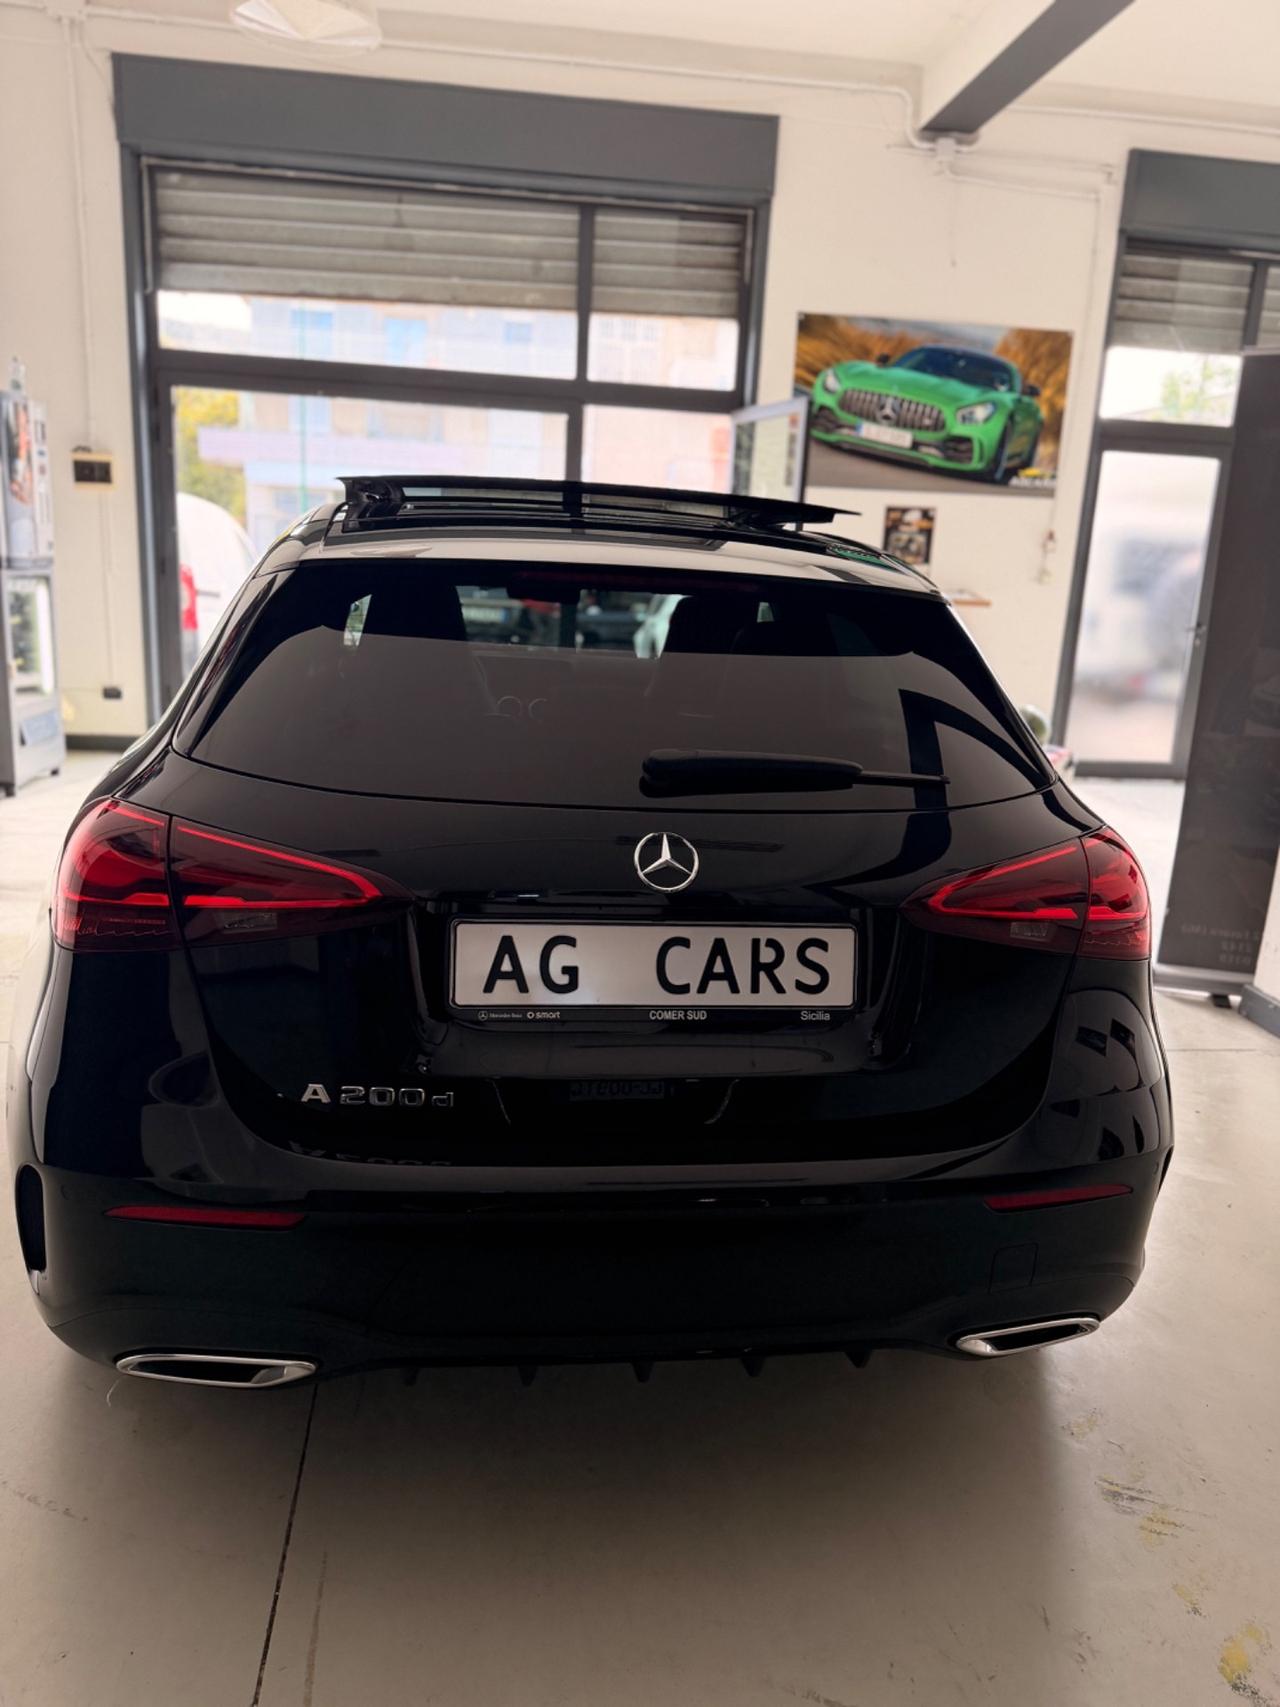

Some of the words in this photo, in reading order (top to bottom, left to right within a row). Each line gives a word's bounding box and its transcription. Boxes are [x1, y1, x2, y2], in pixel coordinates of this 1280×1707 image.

[483, 935, 579, 994] AG
[656, 936, 830, 994] CARS
[535, 1010, 561, 1020] smart
[649, 1010, 685, 1020] COMER
[687, 1010, 708, 1021] SUD
[800, 1011, 830, 1021] Sicilia
[301, 1083, 331, 1103] A
